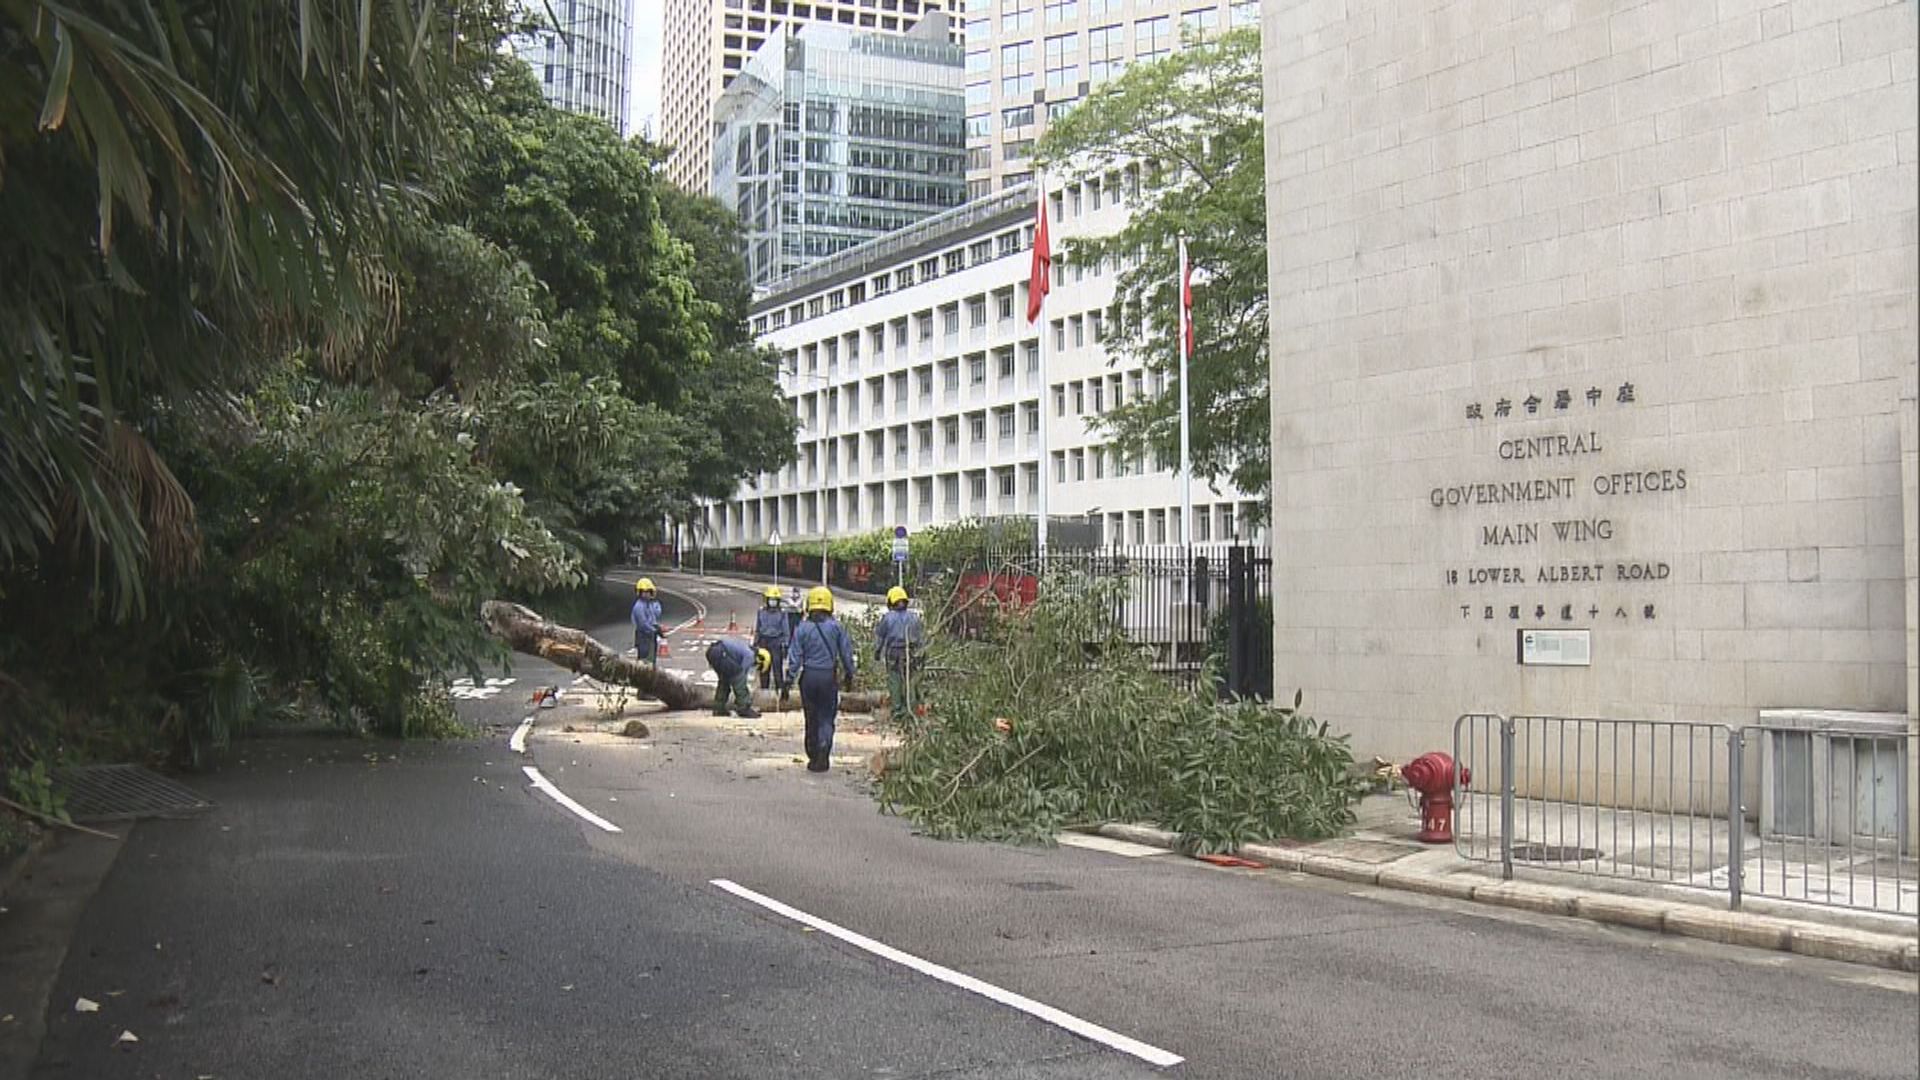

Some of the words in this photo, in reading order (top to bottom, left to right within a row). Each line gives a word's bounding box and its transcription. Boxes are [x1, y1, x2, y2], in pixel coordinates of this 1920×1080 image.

[1499, 431, 1602, 460] CENTRAL
[1430, 477, 1575, 507] GOVERNMENT
[1593, 468, 1687, 496] OFFICES
[1482, 522, 1538, 546] MAIN
[1552, 518, 1614, 542] WING
[1446, 569, 1458, 585] 18
[1468, 567, 1525, 584] LOWER
[1537, 564, 1604, 583] ALBERT
[1615, 562, 1671, 581] ROAD
